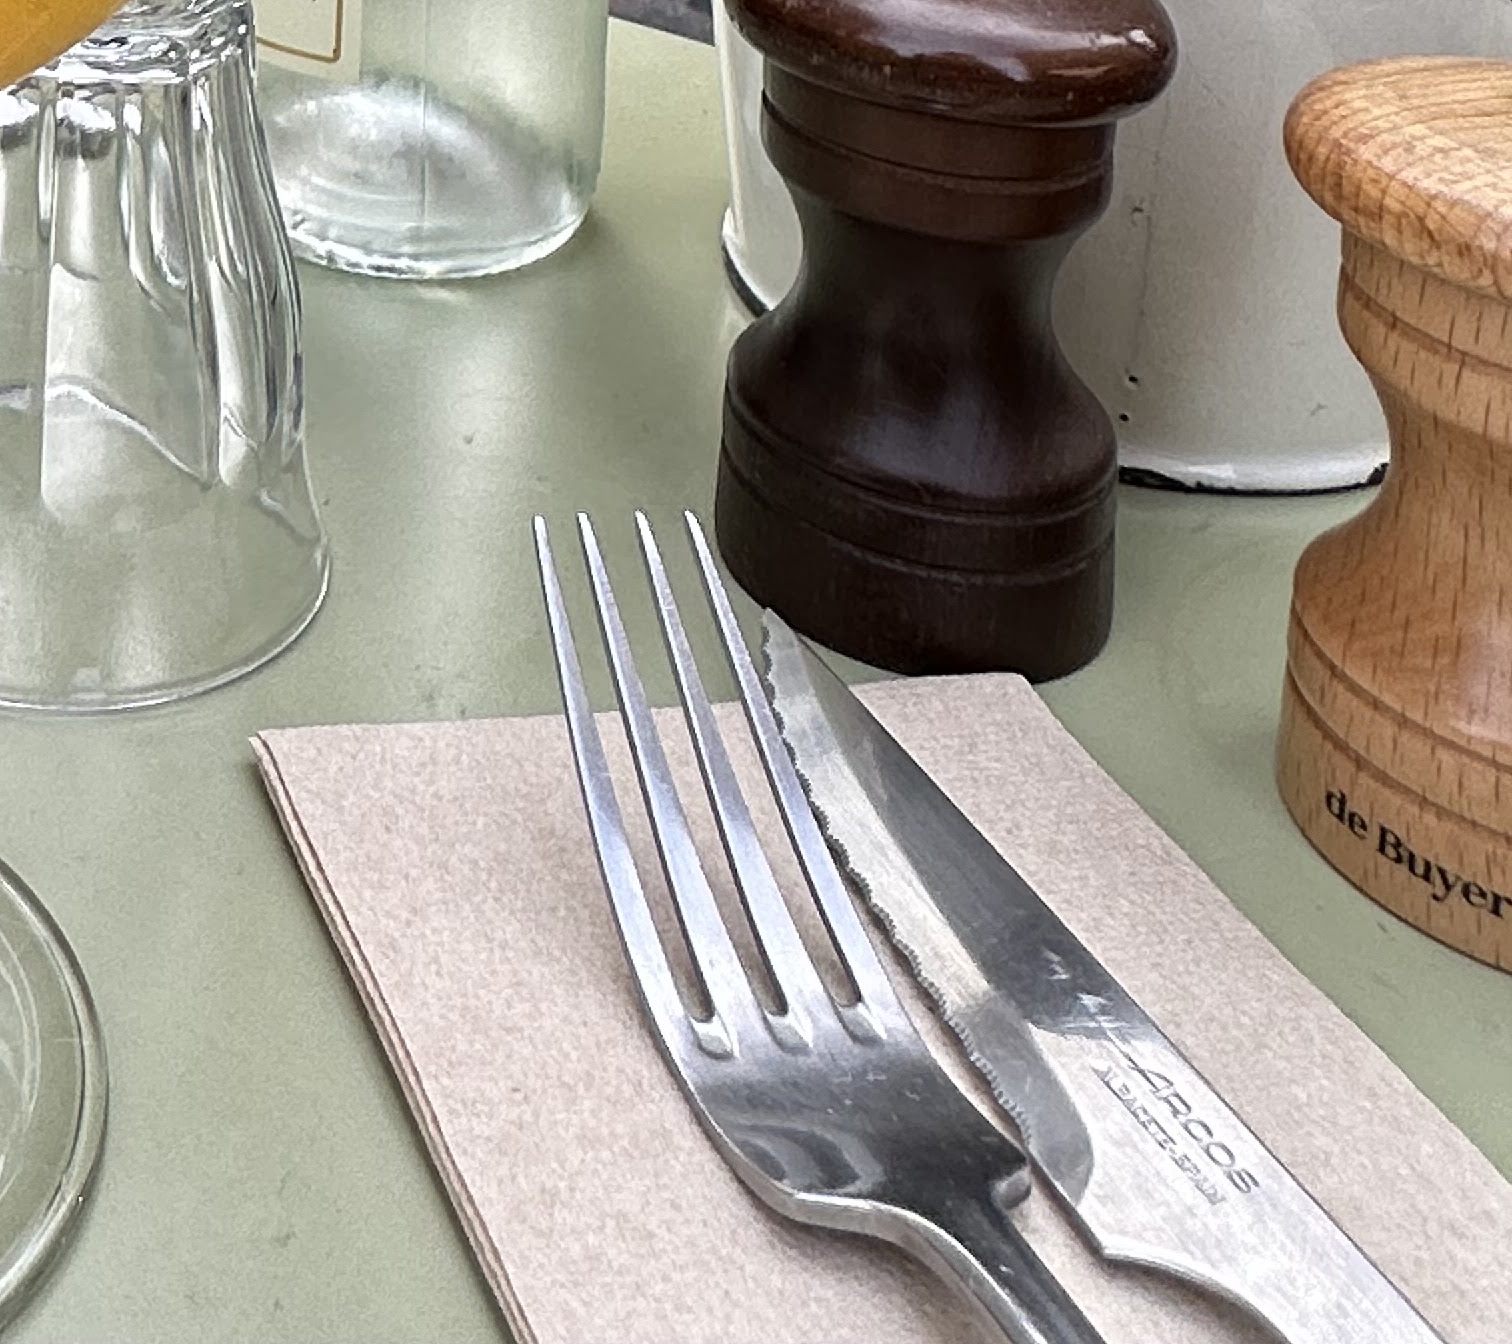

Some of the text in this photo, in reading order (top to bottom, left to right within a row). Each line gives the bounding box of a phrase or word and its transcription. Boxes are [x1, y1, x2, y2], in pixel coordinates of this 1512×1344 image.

[1325, 788, 1512, 919] de Buyer
[1120, 1050, 1260, 1195] ARCOS
